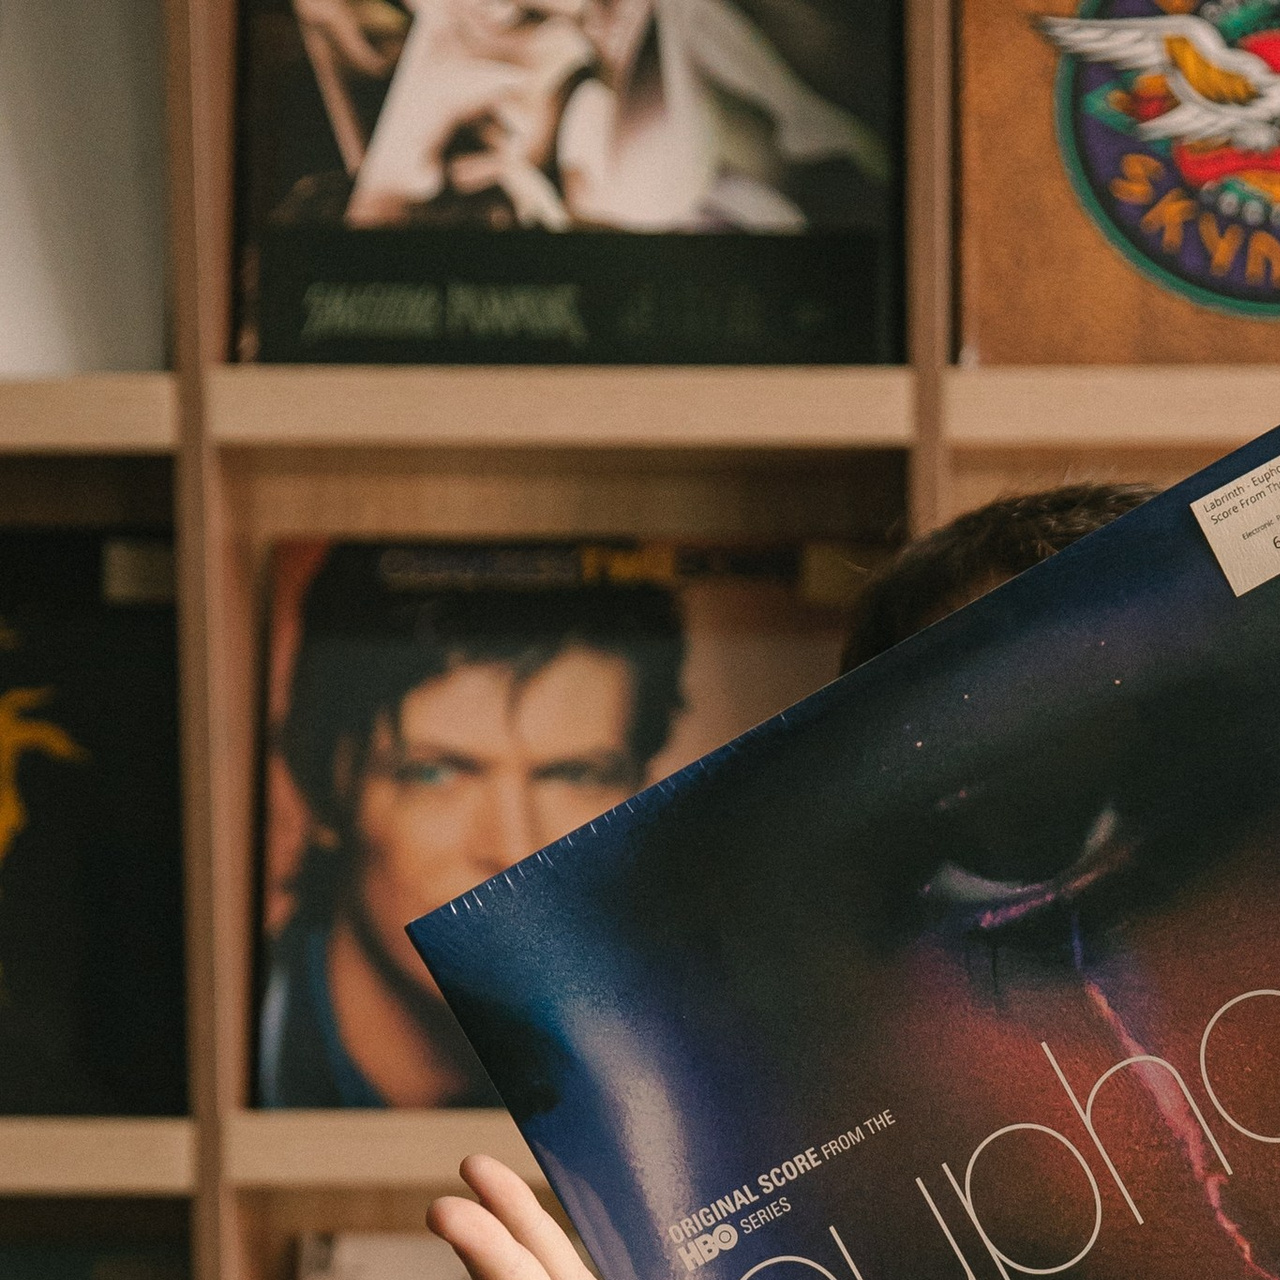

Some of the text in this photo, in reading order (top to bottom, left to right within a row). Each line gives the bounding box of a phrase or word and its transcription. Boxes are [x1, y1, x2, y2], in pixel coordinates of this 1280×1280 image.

[1203, 485, 1245, 513] Labrinth
[1210, 505, 1240, 526] Score
[1240, 490, 1267, 509] From
[668, 1108, 896, 1244] ORIGINAL SCORE FROM THE
[677, 1196, 792, 1272] HBO SERIES
